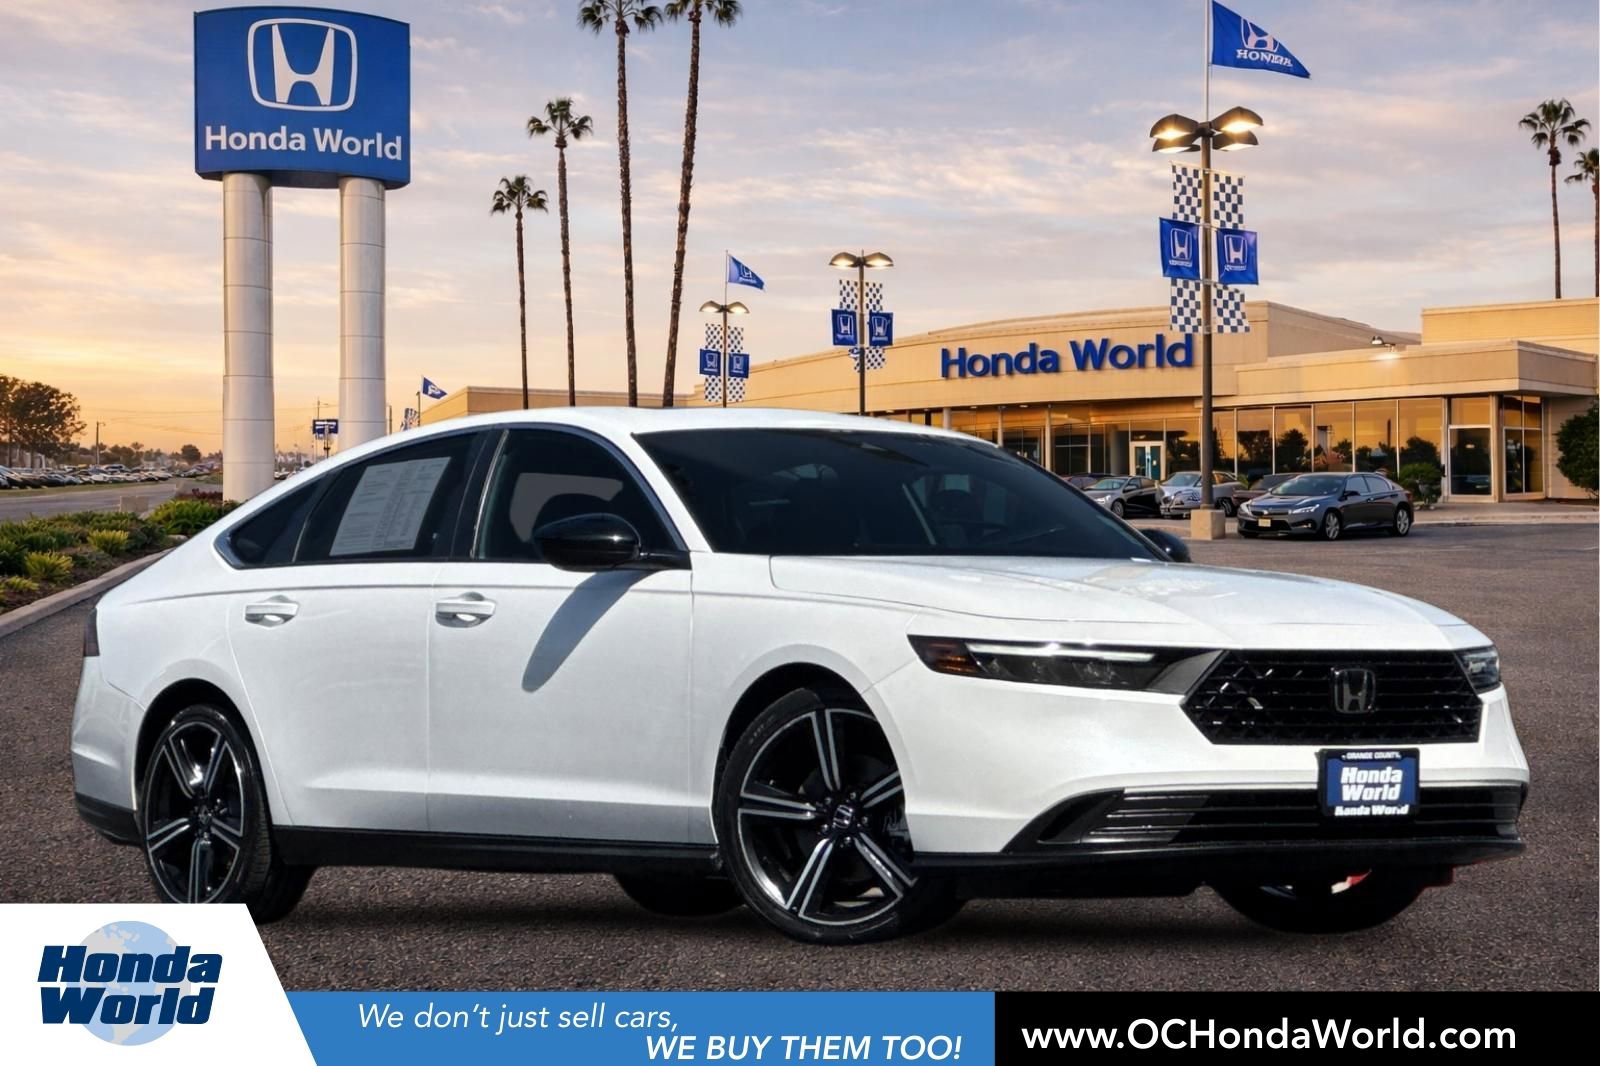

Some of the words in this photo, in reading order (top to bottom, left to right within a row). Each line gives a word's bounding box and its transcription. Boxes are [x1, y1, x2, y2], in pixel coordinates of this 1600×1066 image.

[205, 125, 306, 151] Honda
[313, 127, 402, 161] World
[941, 343, 1061, 377] Honda
[1070, 334, 1194, 370] World
[1341, 766, 1403, 784] Honda
[1342, 783, 1402, 801] World
